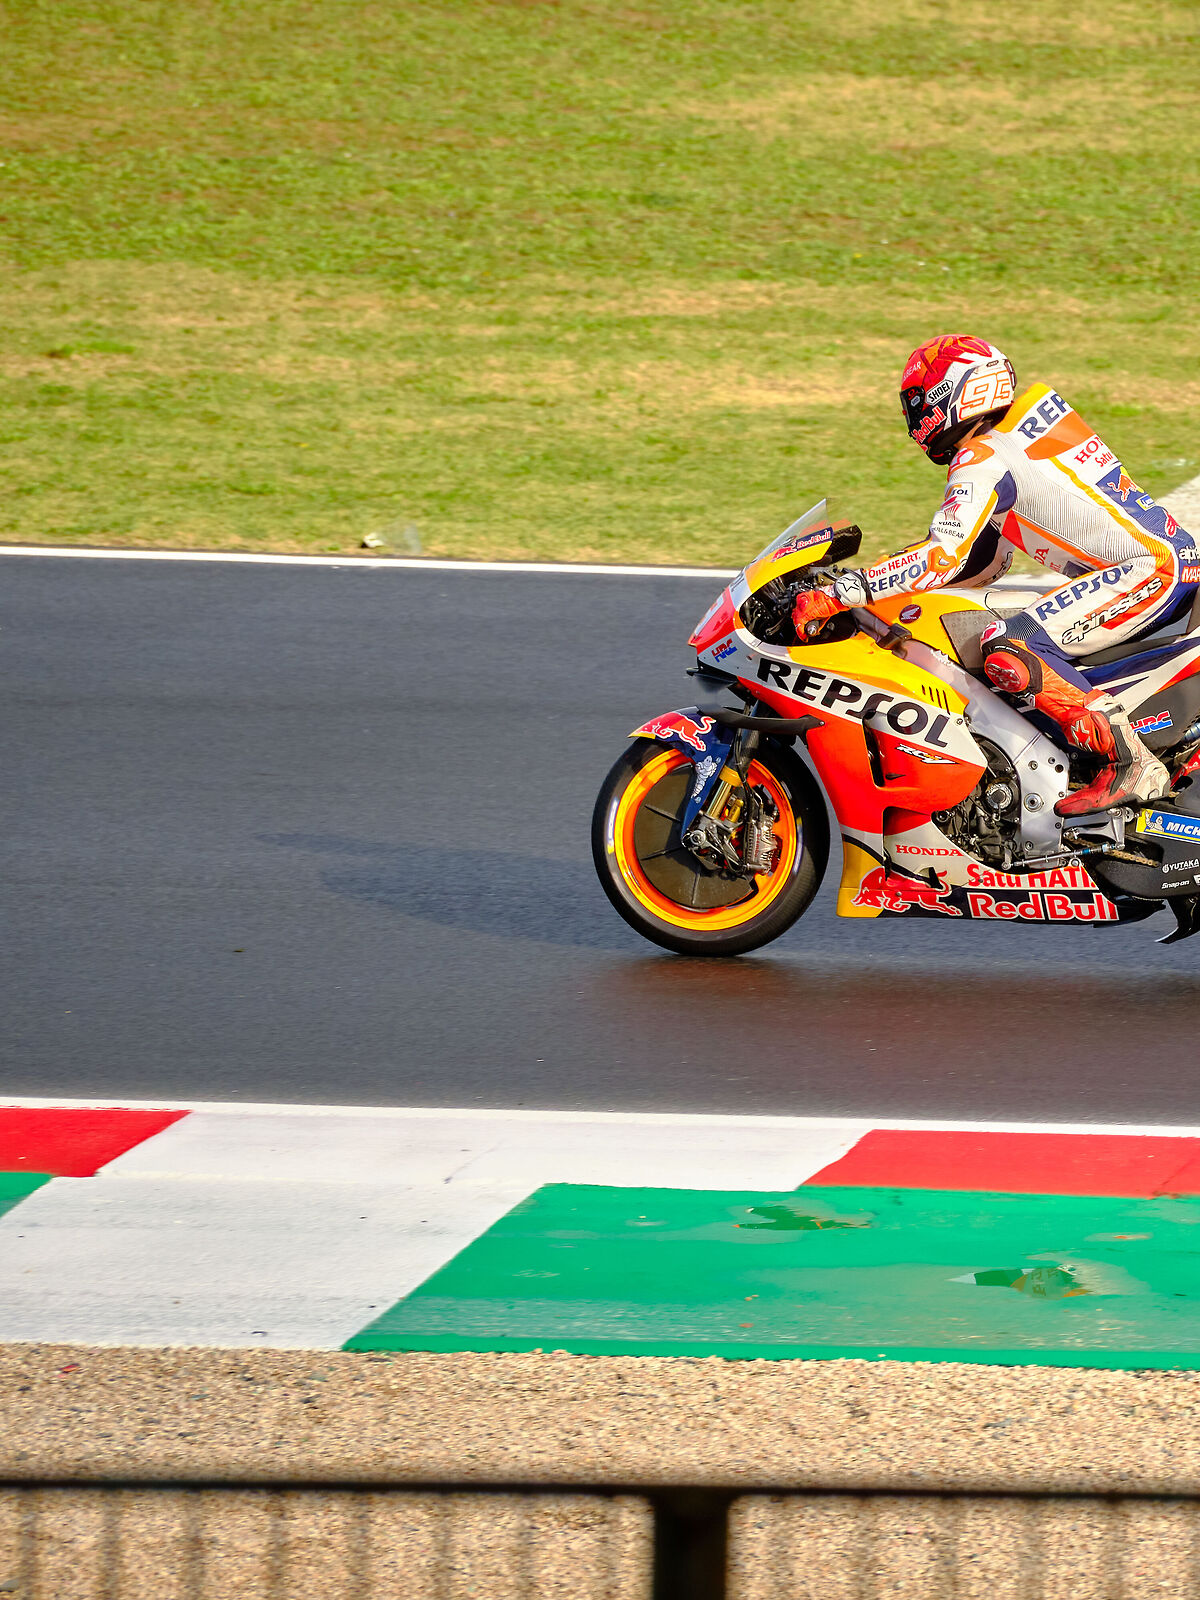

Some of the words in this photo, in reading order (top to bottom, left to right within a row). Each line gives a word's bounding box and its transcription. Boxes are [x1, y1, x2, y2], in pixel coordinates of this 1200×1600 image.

[928, 382, 951, 402] SHOEI
[922, 405, 947, 431] Bull
[797, 537, 814, 549] Red
[815, 529, 831, 543] Bull
[868, 567, 886, 579] One
[888, 552, 921, 572] HEART.
[1035, 562, 1134, 621] REPSOL
[1061, 577, 1163, 645] alpinestars
[756, 658, 950, 747] REPSOL
[1129, 710, 1174, 735] HRC
[896, 844, 964, 857] HONDA
[966, 864, 1022, 888] Satu
[1169, 859, 1199, 870] YUTAKA
[967, 892, 1044, 920] Red
[1044, 892, 1119, 921] Bull
